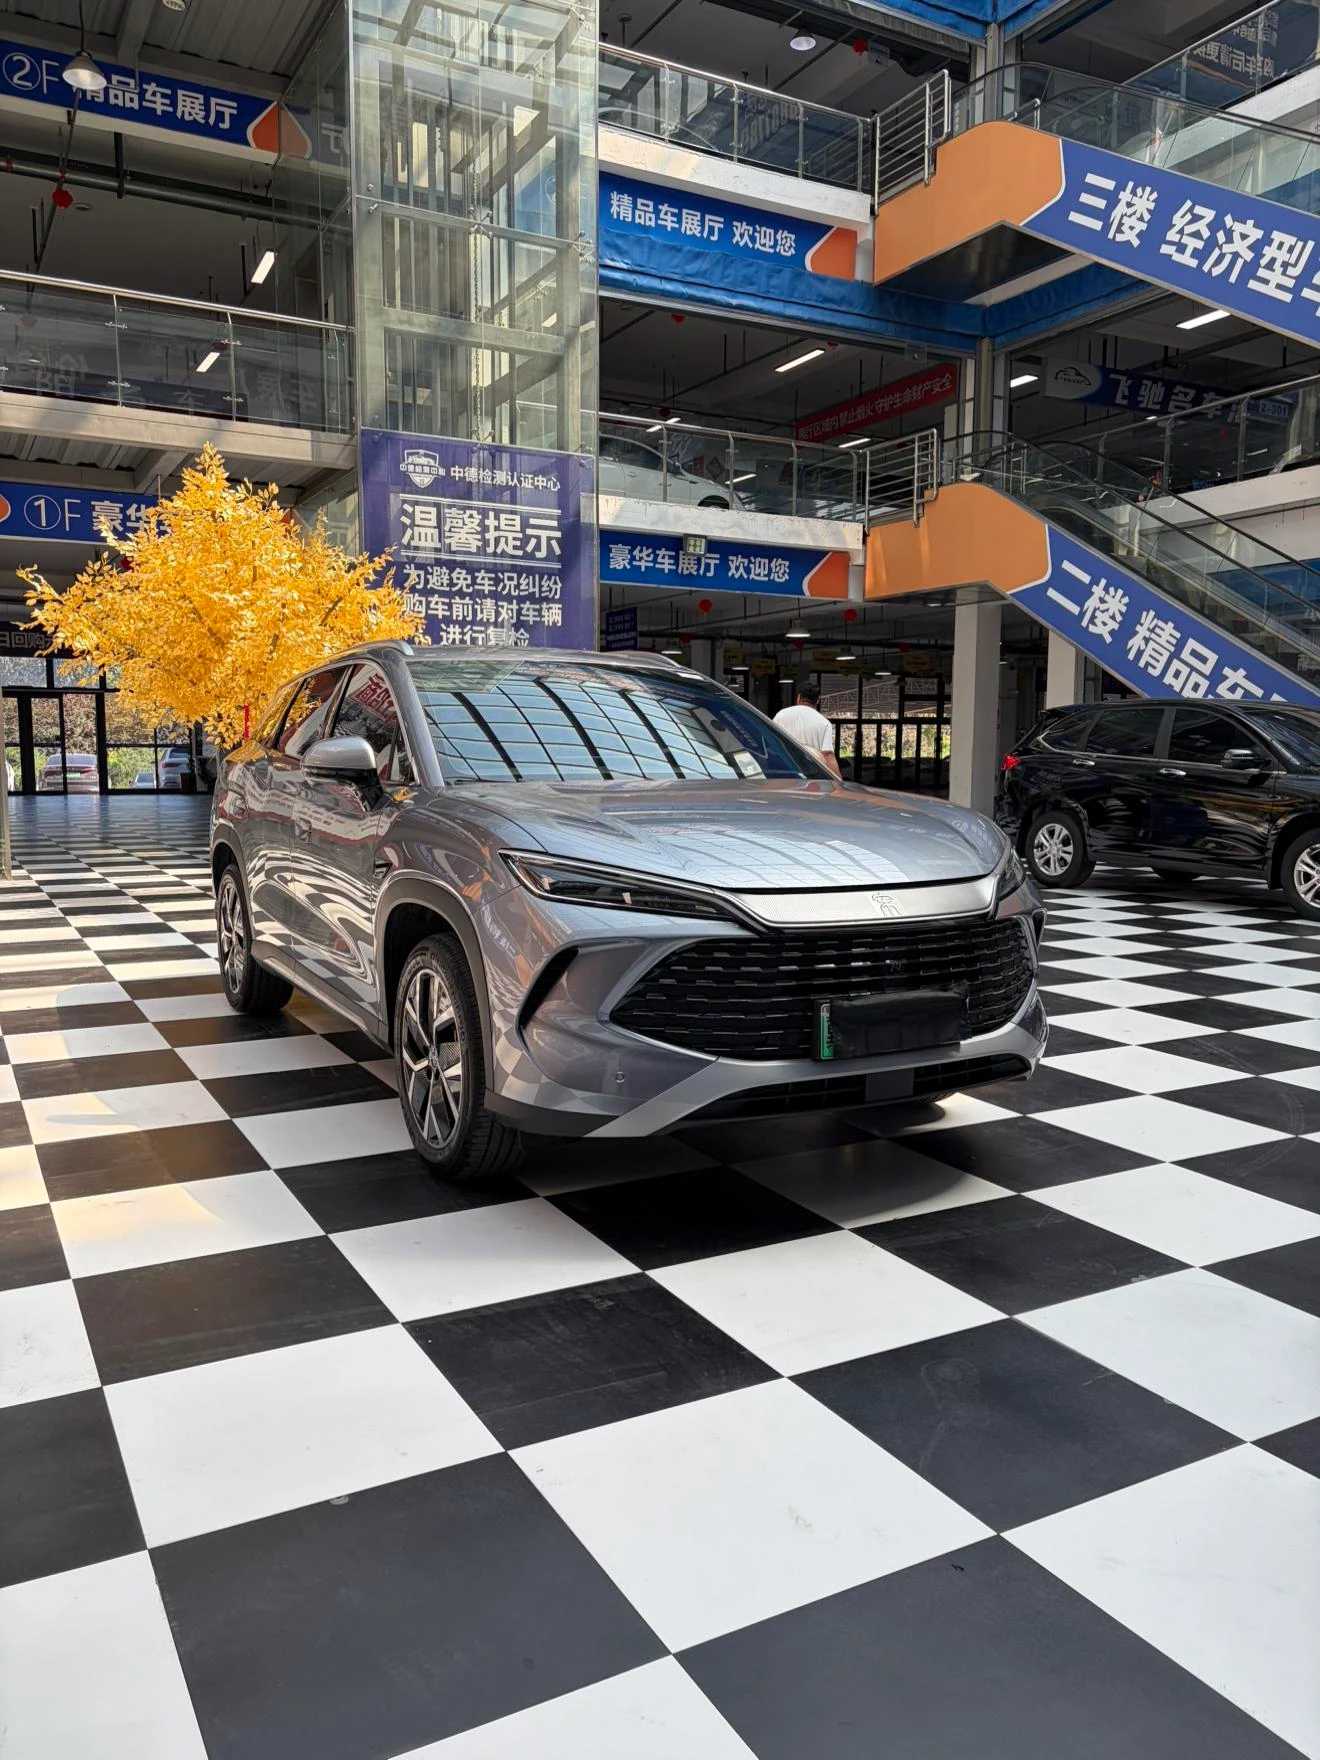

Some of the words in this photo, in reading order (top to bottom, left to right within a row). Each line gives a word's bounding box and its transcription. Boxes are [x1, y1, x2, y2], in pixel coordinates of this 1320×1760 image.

[610, 191, 724, 242] 精品车展厅
[732, 221, 796, 257] 欢迎您
[1067, 172, 1159, 248] 三楼
[450, 465, 560, 492] 中德检测认证中心
[91, 500, 175, 533] 豪华
[400, 503, 562, 559] 温馨提示
[608, 544, 720, 577] 豪华车展厅
[728, 555, 790, 582] 欢迎您
[403, 564, 562, 599] 为避免车况纠纷
[404, 593, 562, 627] 购车前请对车辆
[0, 631, 53, 649] 日回购
[440, 624, 530, 646] 进行复检
[1046, 559, 1130, 645] 二楼
[1126, 609, 1288, 701] 精品车
